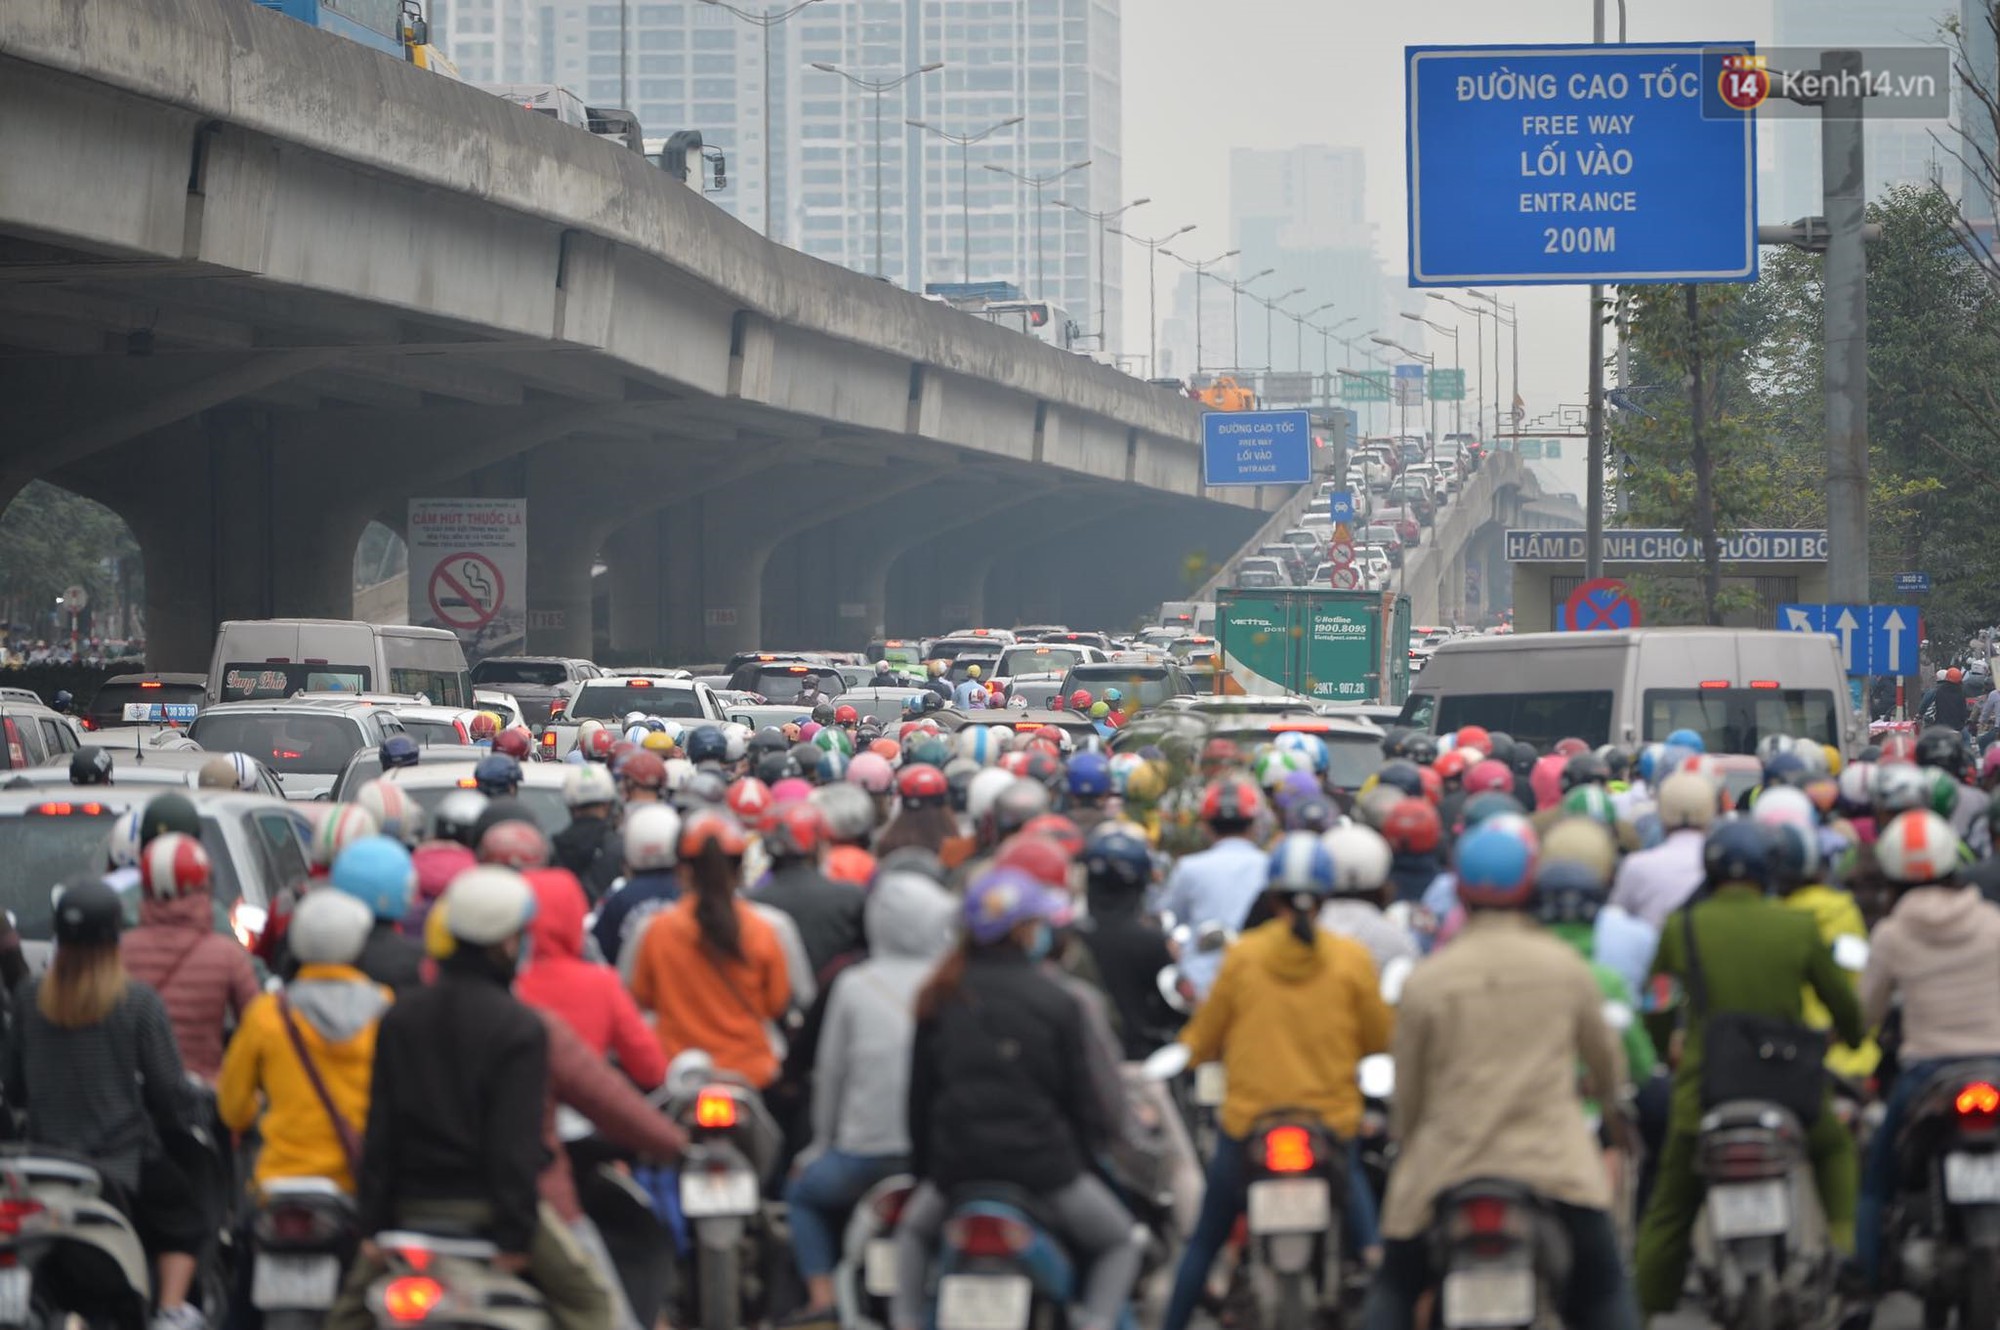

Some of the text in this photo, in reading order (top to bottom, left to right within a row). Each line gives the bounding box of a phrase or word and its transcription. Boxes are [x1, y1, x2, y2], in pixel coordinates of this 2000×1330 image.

[1456, 63, 1699, 101] ĐƯỜNG CAO TỐC
[1522, 114, 1635, 135] FREE WAY
[1521, 141, 1633, 176] LỐI VÀO
[1519, 192, 1637, 212] ENTRANCE
[1543, 226, 1616, 253] 200M
[1254, 424, 1273, 433] CAO
[1276, 421, 1295, 433] TỐC
[1237, 449, 1272, 461] LỐI VÀO
[1510, 532, 1564, 557] HẦM
[1569, 537, 1636, 557] DNH
[1641, 537, 1687, 557] CHO
[1773, 537, 1796, 557] ĐI
[1315, 624, 1366, 633] 1900.8095
